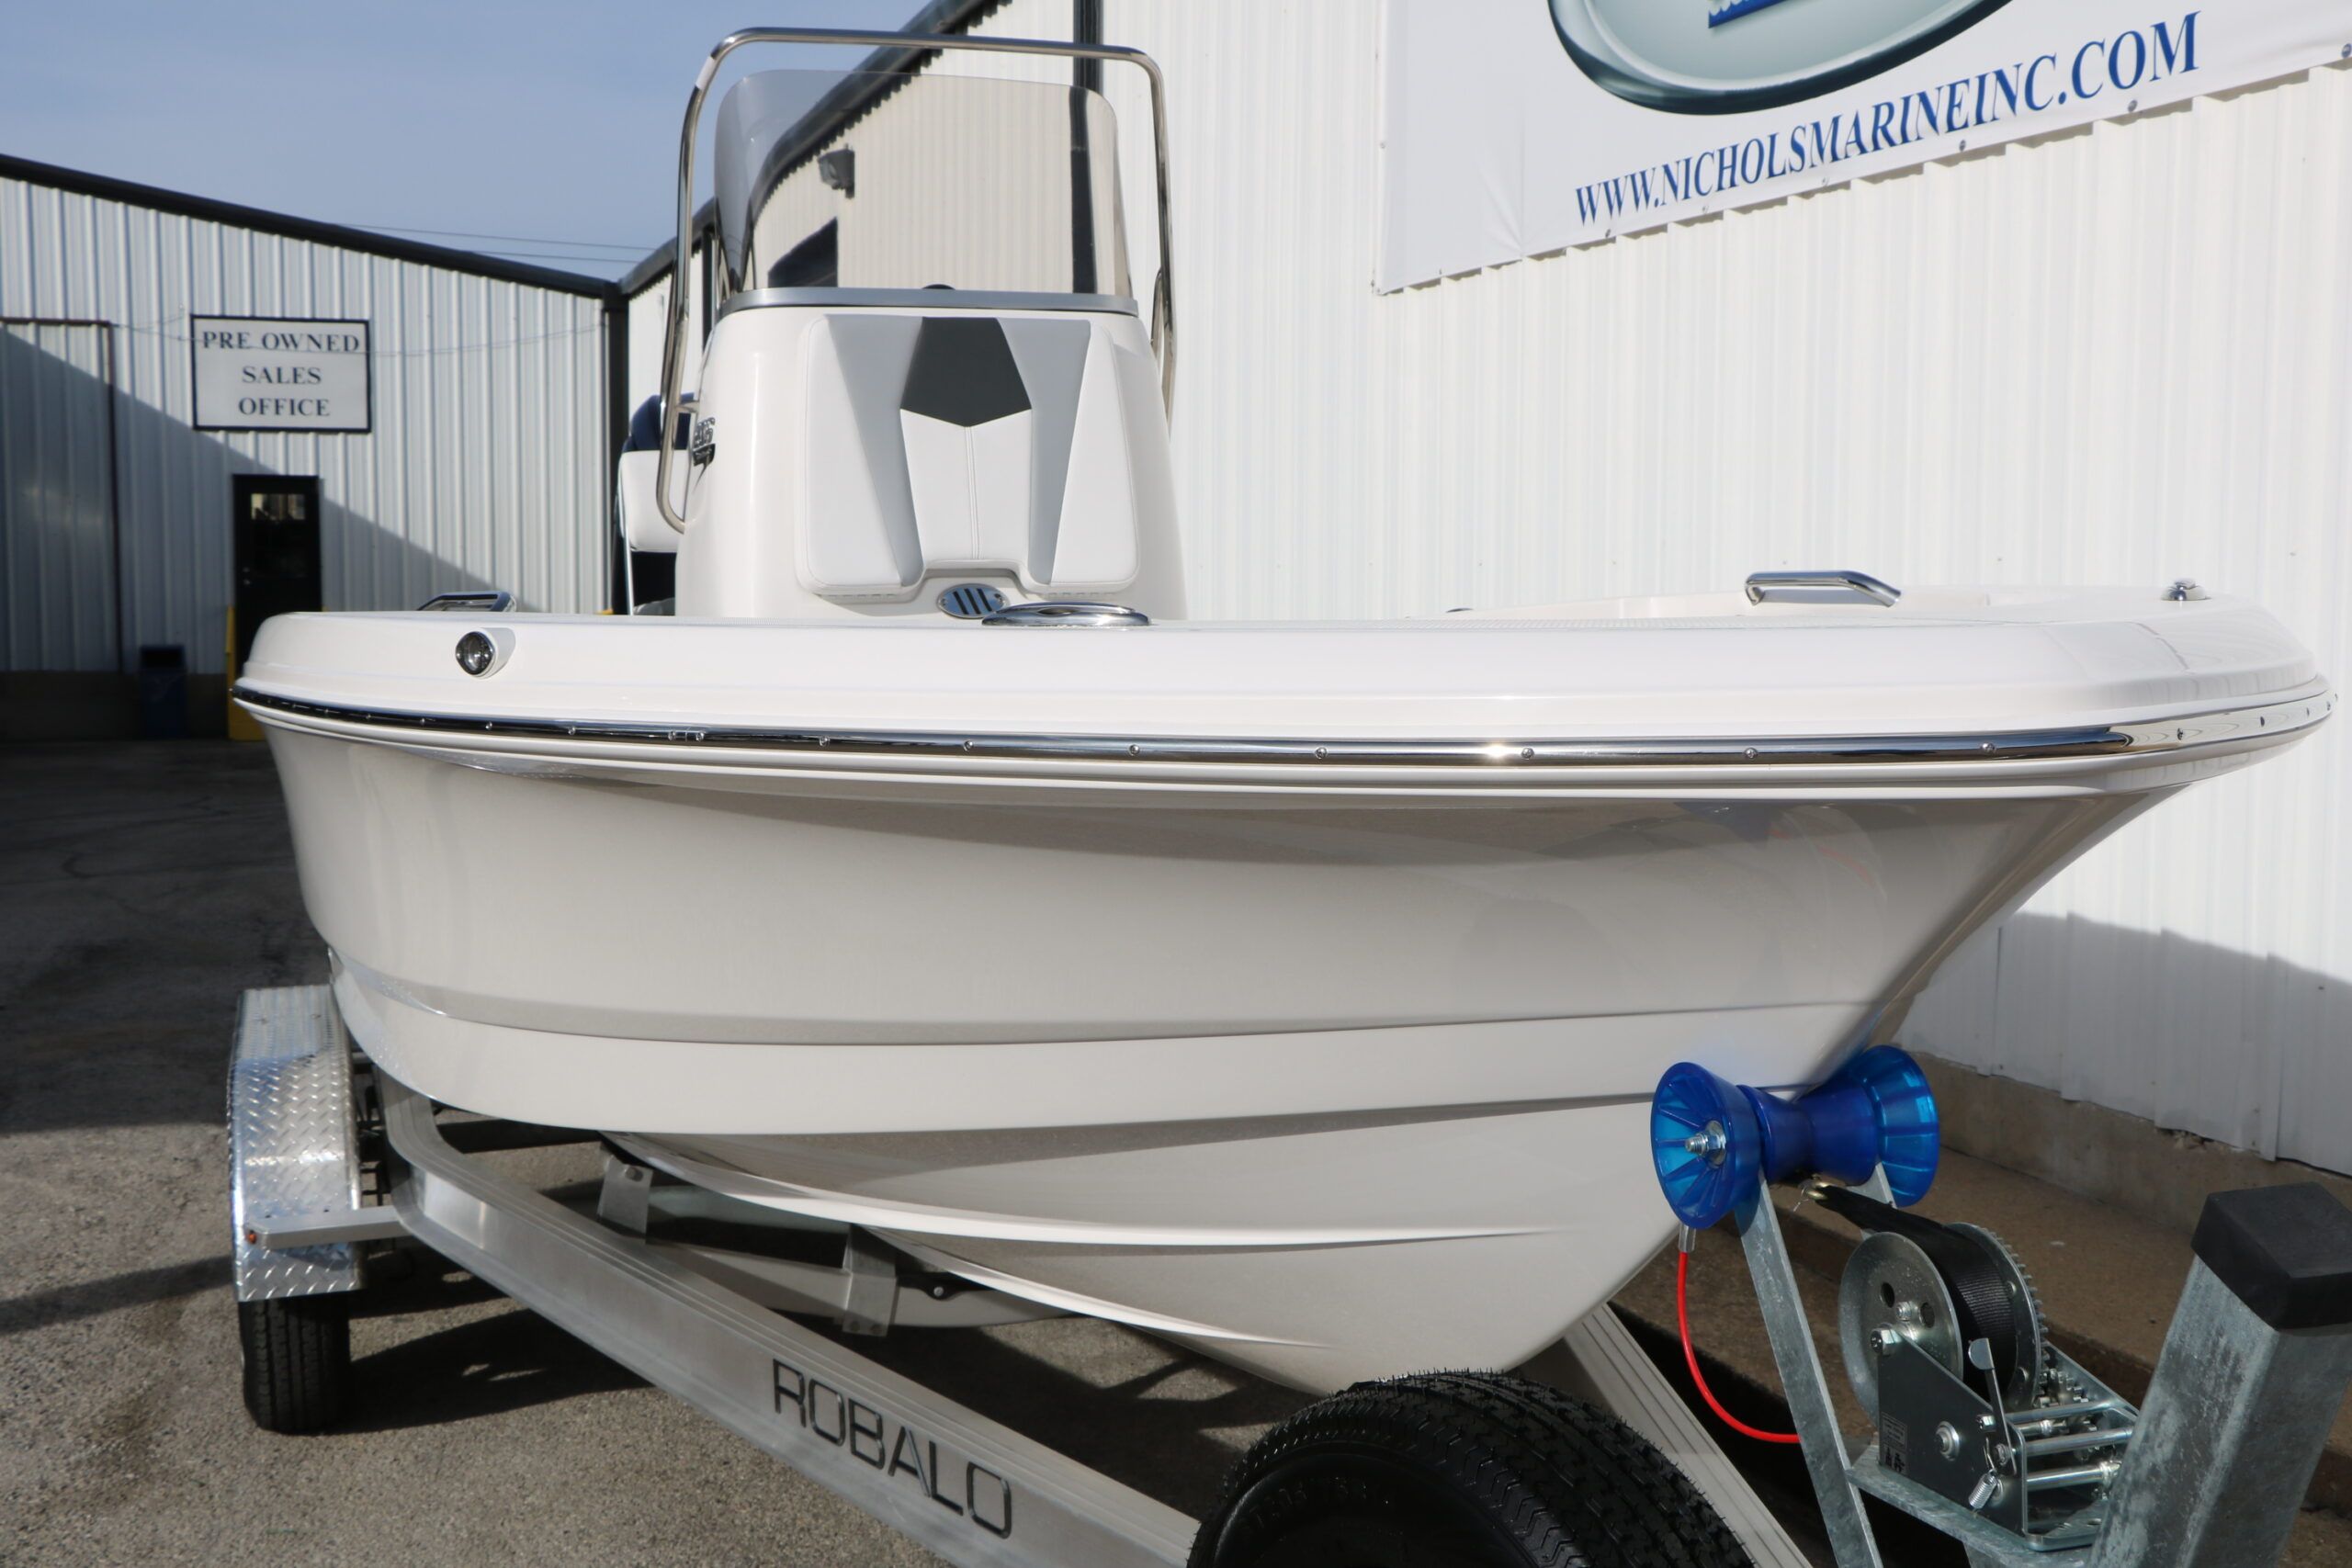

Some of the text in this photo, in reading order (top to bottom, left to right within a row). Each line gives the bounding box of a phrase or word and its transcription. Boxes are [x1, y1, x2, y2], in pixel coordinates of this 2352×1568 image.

[1575, 10, 2202, 227] WWW.NICHOLSMARINEINC.COM
[202, 331, 360, 353] PRE OWNED
[242, 366, 322, 384] SALES
[238, 397, 331, 416] OFFICE
[773, 1358, 1012, 1540] ROBALO
